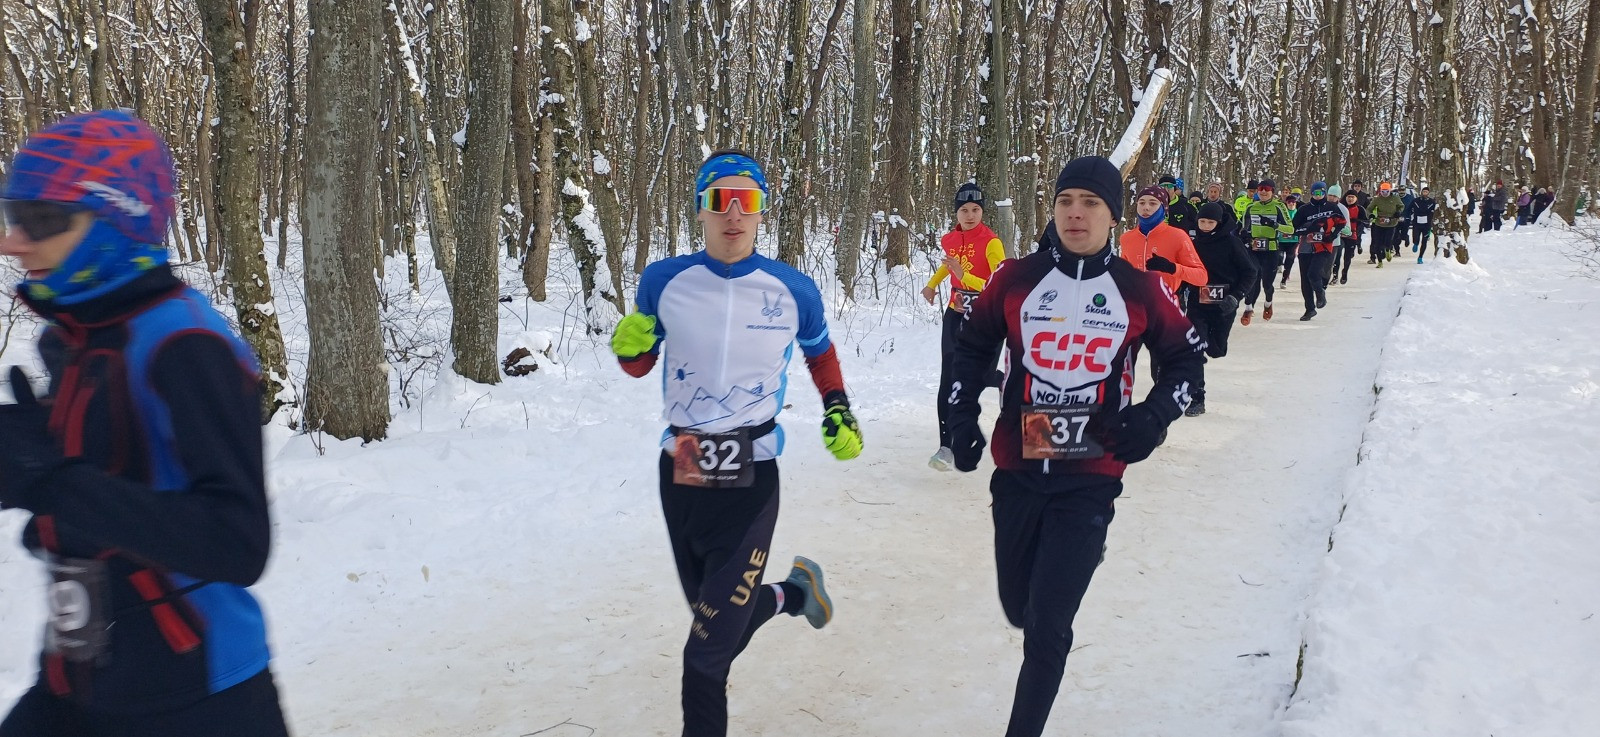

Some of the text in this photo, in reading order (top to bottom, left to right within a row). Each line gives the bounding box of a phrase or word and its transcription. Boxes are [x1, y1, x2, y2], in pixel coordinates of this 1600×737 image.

[1307, 210, 1333, 220] SCOTT
[1256, 240, 1266, 248] 31
[1209, 288, 1224, 299] 41
[963, 295, 979, 308] 2
[1082, 319, 1126, 330] cervélo
[1030, 332, 1113, 373] CSC
[1051, 415, 1090, 445] 37
[698, 439, 742, 471] 32
[730, 547, 767, 607] UAE
